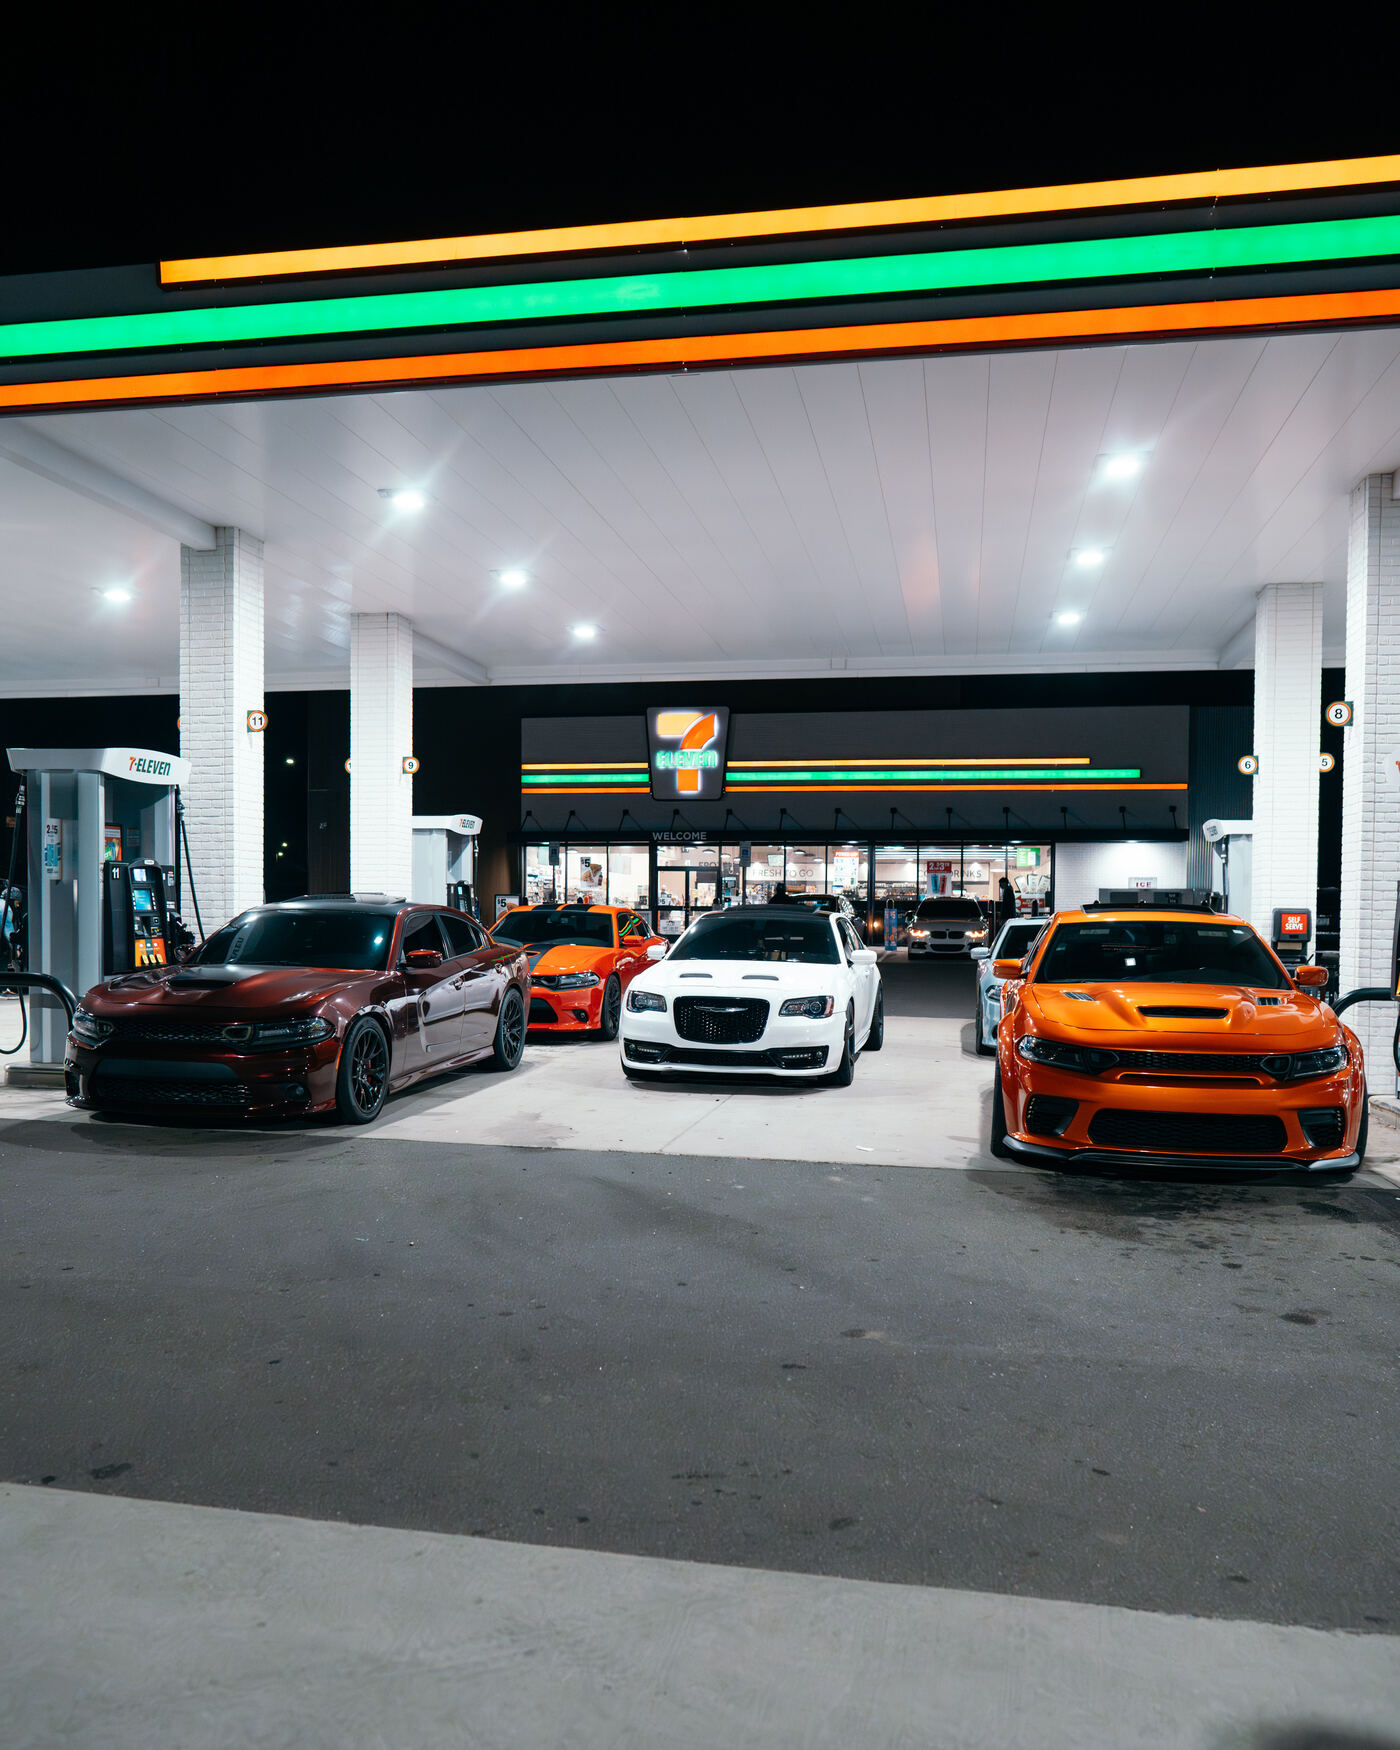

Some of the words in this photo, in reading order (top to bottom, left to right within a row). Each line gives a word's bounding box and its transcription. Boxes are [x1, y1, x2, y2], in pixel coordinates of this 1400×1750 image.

[1334, 708, 1343, 719] 8
[252, 716, 263, 726] 11
[657, 712, 716, 792] 7
[408, 761, 414, 769] 9
[1244, 761, 1251, 769] 6
[1321, 758, 1328, 767] 5
[652, 832, 707, 840] WELCOME
[112, 867, 120, 879] 11
[752, 869, 782, 877] FRESH
[799, 869, 814, 878] GO
[1285, 923, 1304, 931] SERVE
